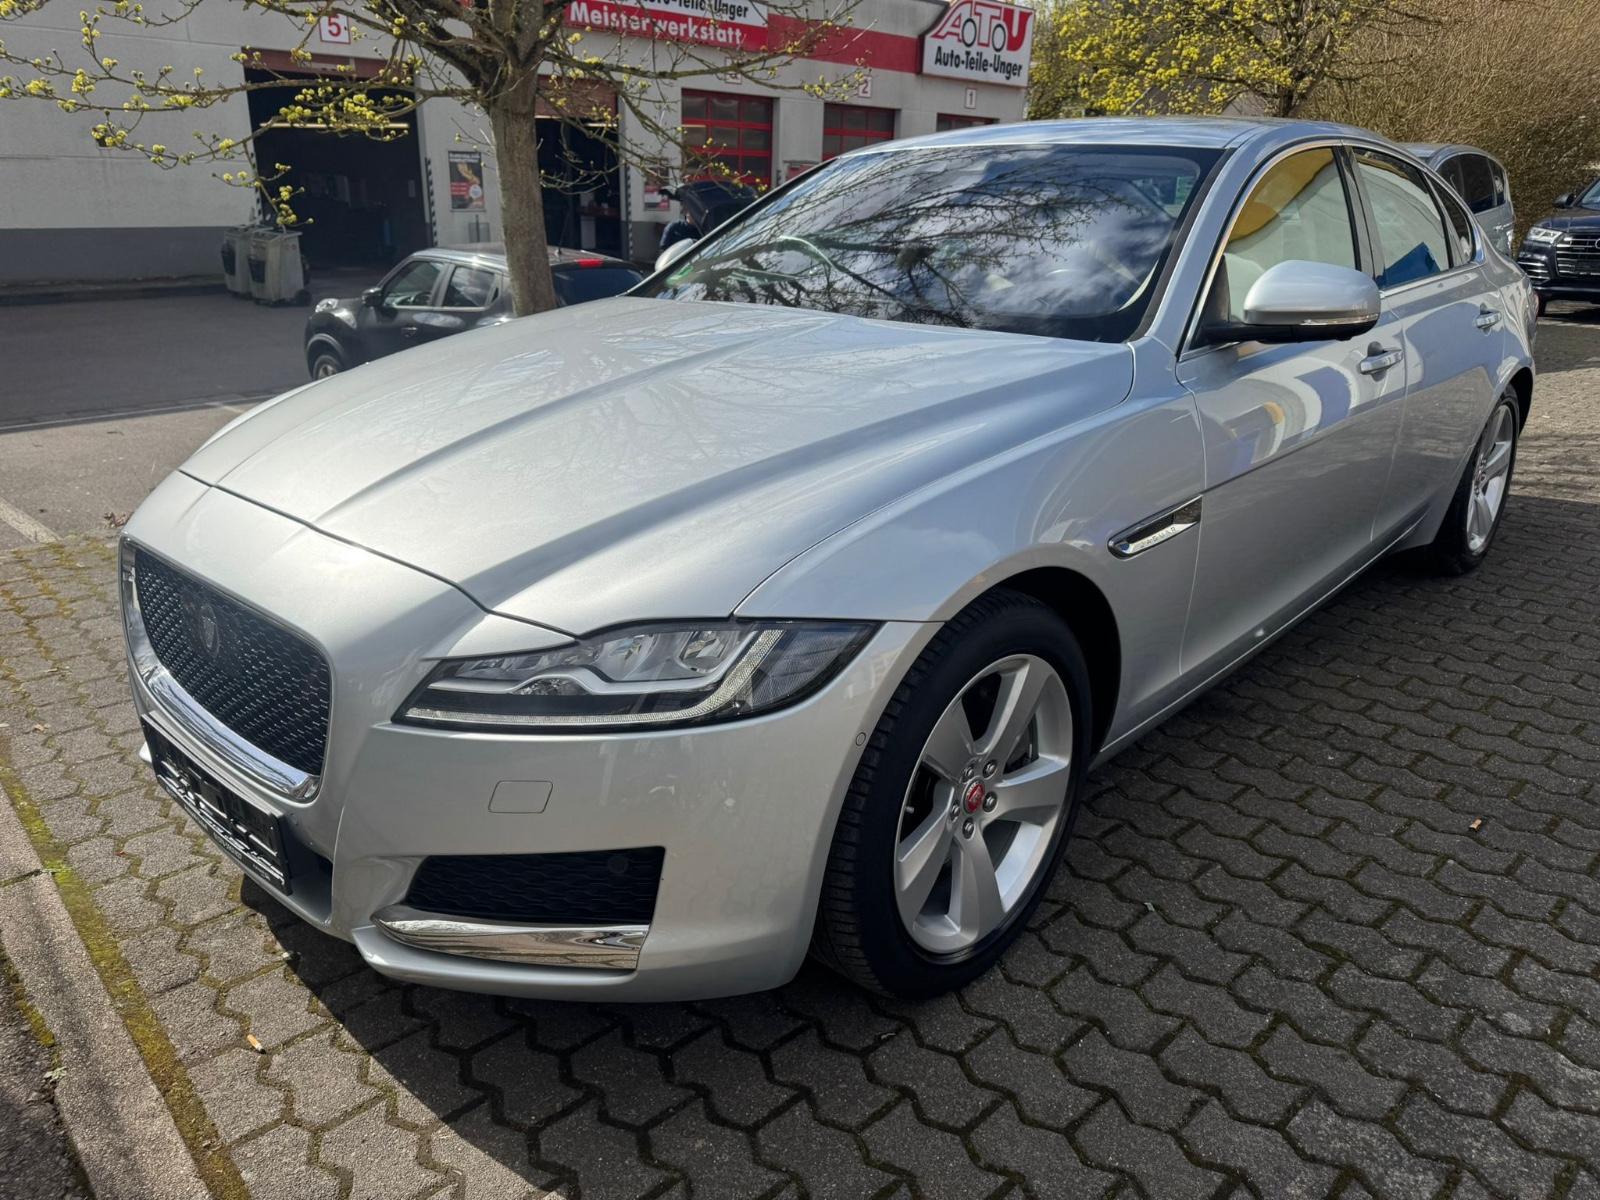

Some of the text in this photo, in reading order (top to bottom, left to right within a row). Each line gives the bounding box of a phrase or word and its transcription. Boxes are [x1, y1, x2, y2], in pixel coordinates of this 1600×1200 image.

[328, 14, 341, 37] 5
[570, 1, 742, 44] Meisterwerkstatt
[934, 45, 1022, 81] Auto-Teile-Unger
[861, 79, 869, 94] 2
